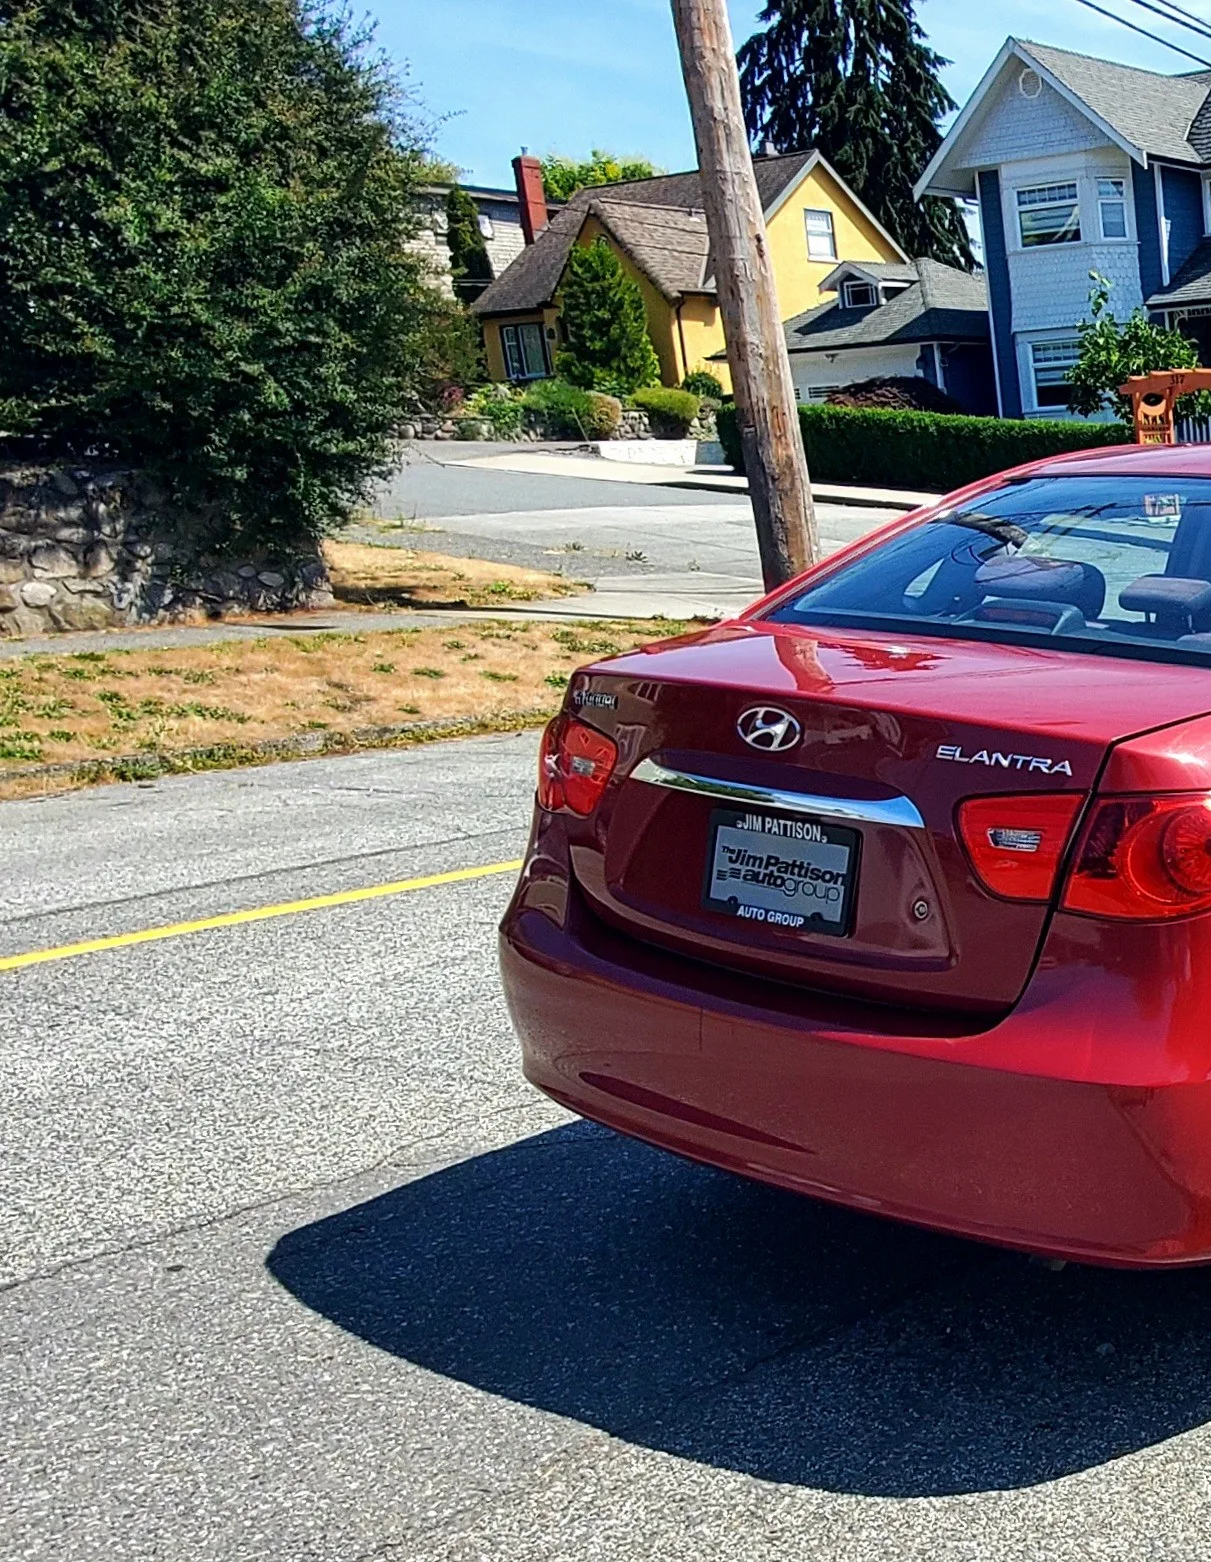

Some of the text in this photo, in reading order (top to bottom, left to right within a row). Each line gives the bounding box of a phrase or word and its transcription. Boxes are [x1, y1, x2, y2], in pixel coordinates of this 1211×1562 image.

[936, 745, 1073, 776] ELANTRA
[743, 813, 822, 842] JIM PATTISON
[722, 845, 736, 854] The
[736, 905, 804, 928] AUTO GROUP
